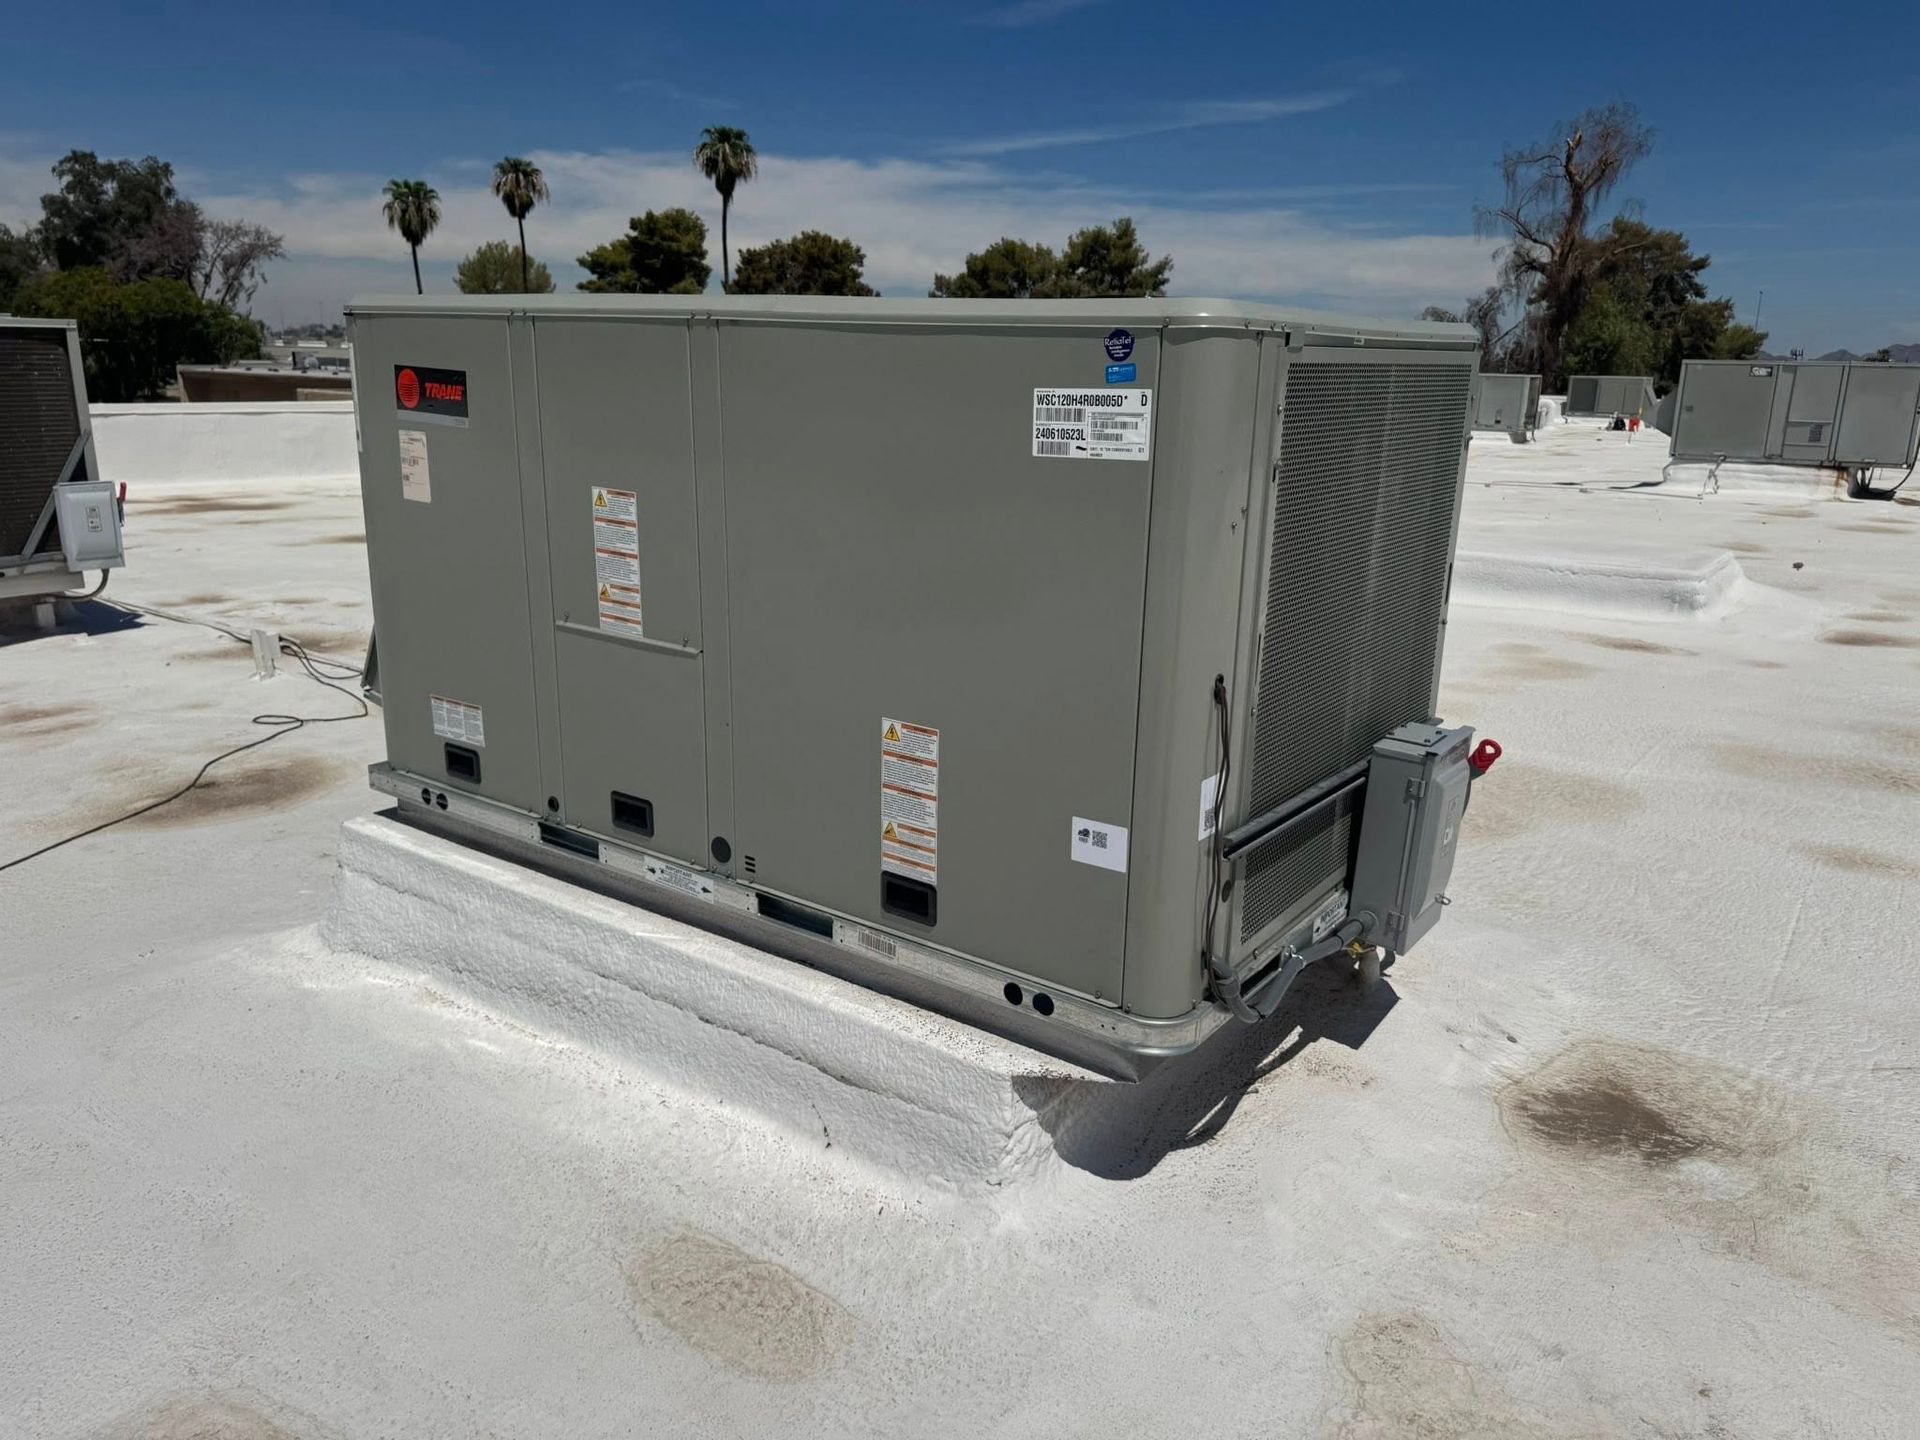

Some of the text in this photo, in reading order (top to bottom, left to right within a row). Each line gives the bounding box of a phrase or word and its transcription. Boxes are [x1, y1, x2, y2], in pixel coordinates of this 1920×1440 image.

[425, 382, 464, 401] TRANE
[1141, 395, 1148, 406] D
[1035, 428, 1086, 441] 240610523L
